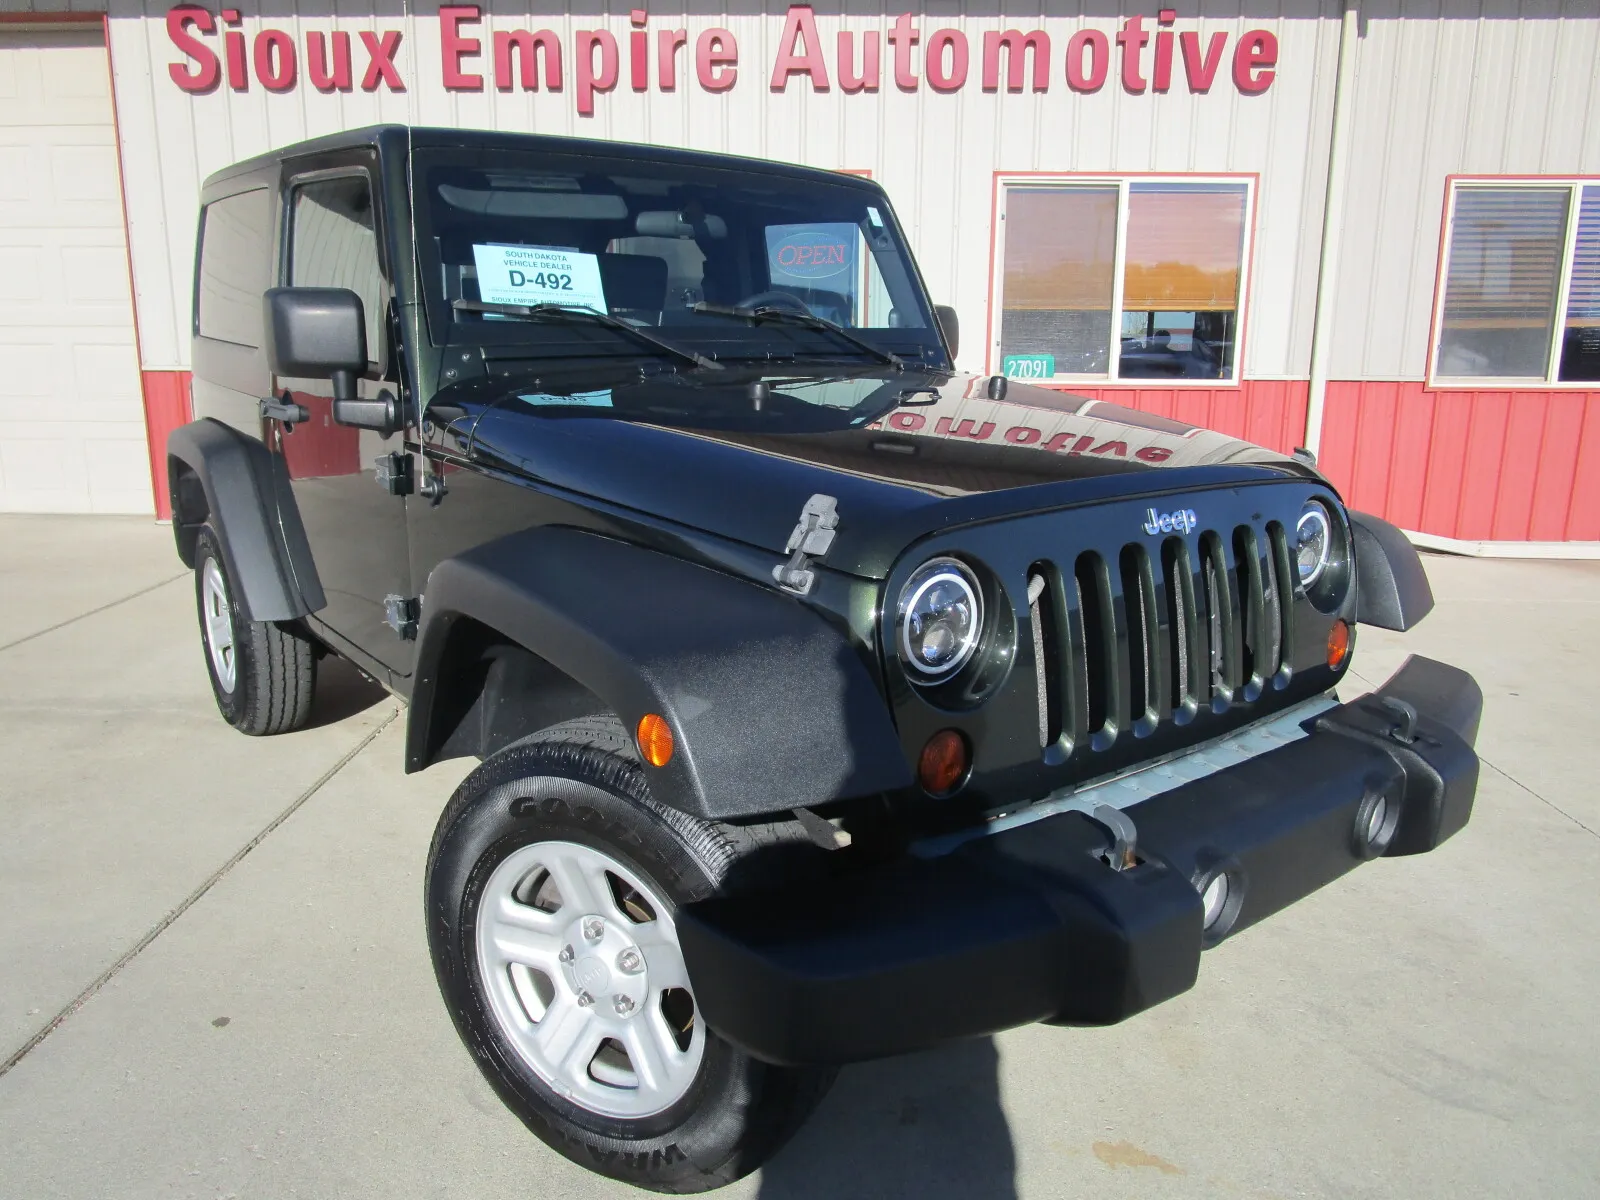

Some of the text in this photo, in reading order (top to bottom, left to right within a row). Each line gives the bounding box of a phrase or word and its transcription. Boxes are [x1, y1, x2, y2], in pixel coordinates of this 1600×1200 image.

[166, 4, 1278, 115] Sioux Empire Automotive
[503, 259, 572, 270] VEHICLE DEALER
[505, 250, 567, 261] SOUTH DAKOTA
[778, 244, 848, 266] OPEN
[509, 270, 573, 290] D-492
[1008, 359, 1047, 378] 27091
[1141, 508, 1197, 535] Jeep
